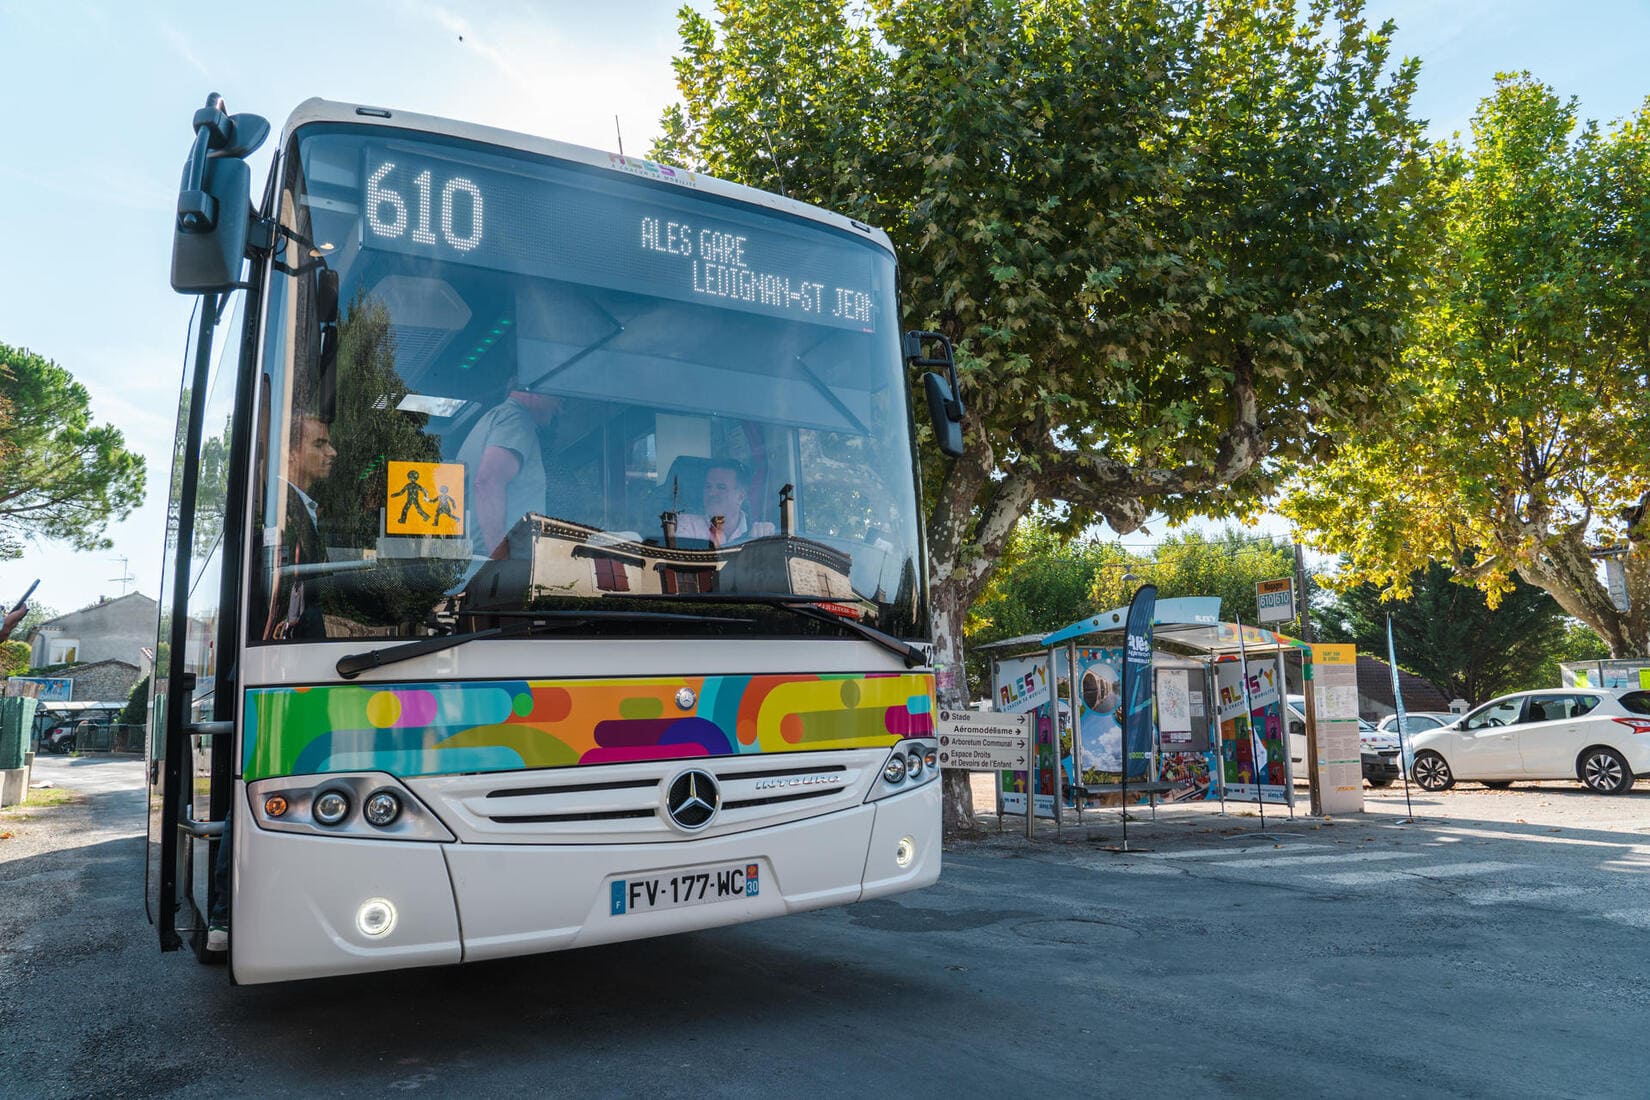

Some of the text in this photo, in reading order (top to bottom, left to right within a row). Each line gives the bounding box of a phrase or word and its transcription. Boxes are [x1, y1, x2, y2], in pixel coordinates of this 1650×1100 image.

[367, 162, 483, 251] 610
[641, 216, 748, 268] ALES GARE
[1000, 664, 1046, 706] ALES'Y
[951, 712, 971, 721] Stade
[954, 725, 1013, 735] Aéromodélisme
[951, 738, 1012, 747] Arboretum Communal
[951, 750, 972, 759] Espace
[755, 776, 840, 790] INTOURO
[615, 869, 758, 910] F FV-177-WC 30
